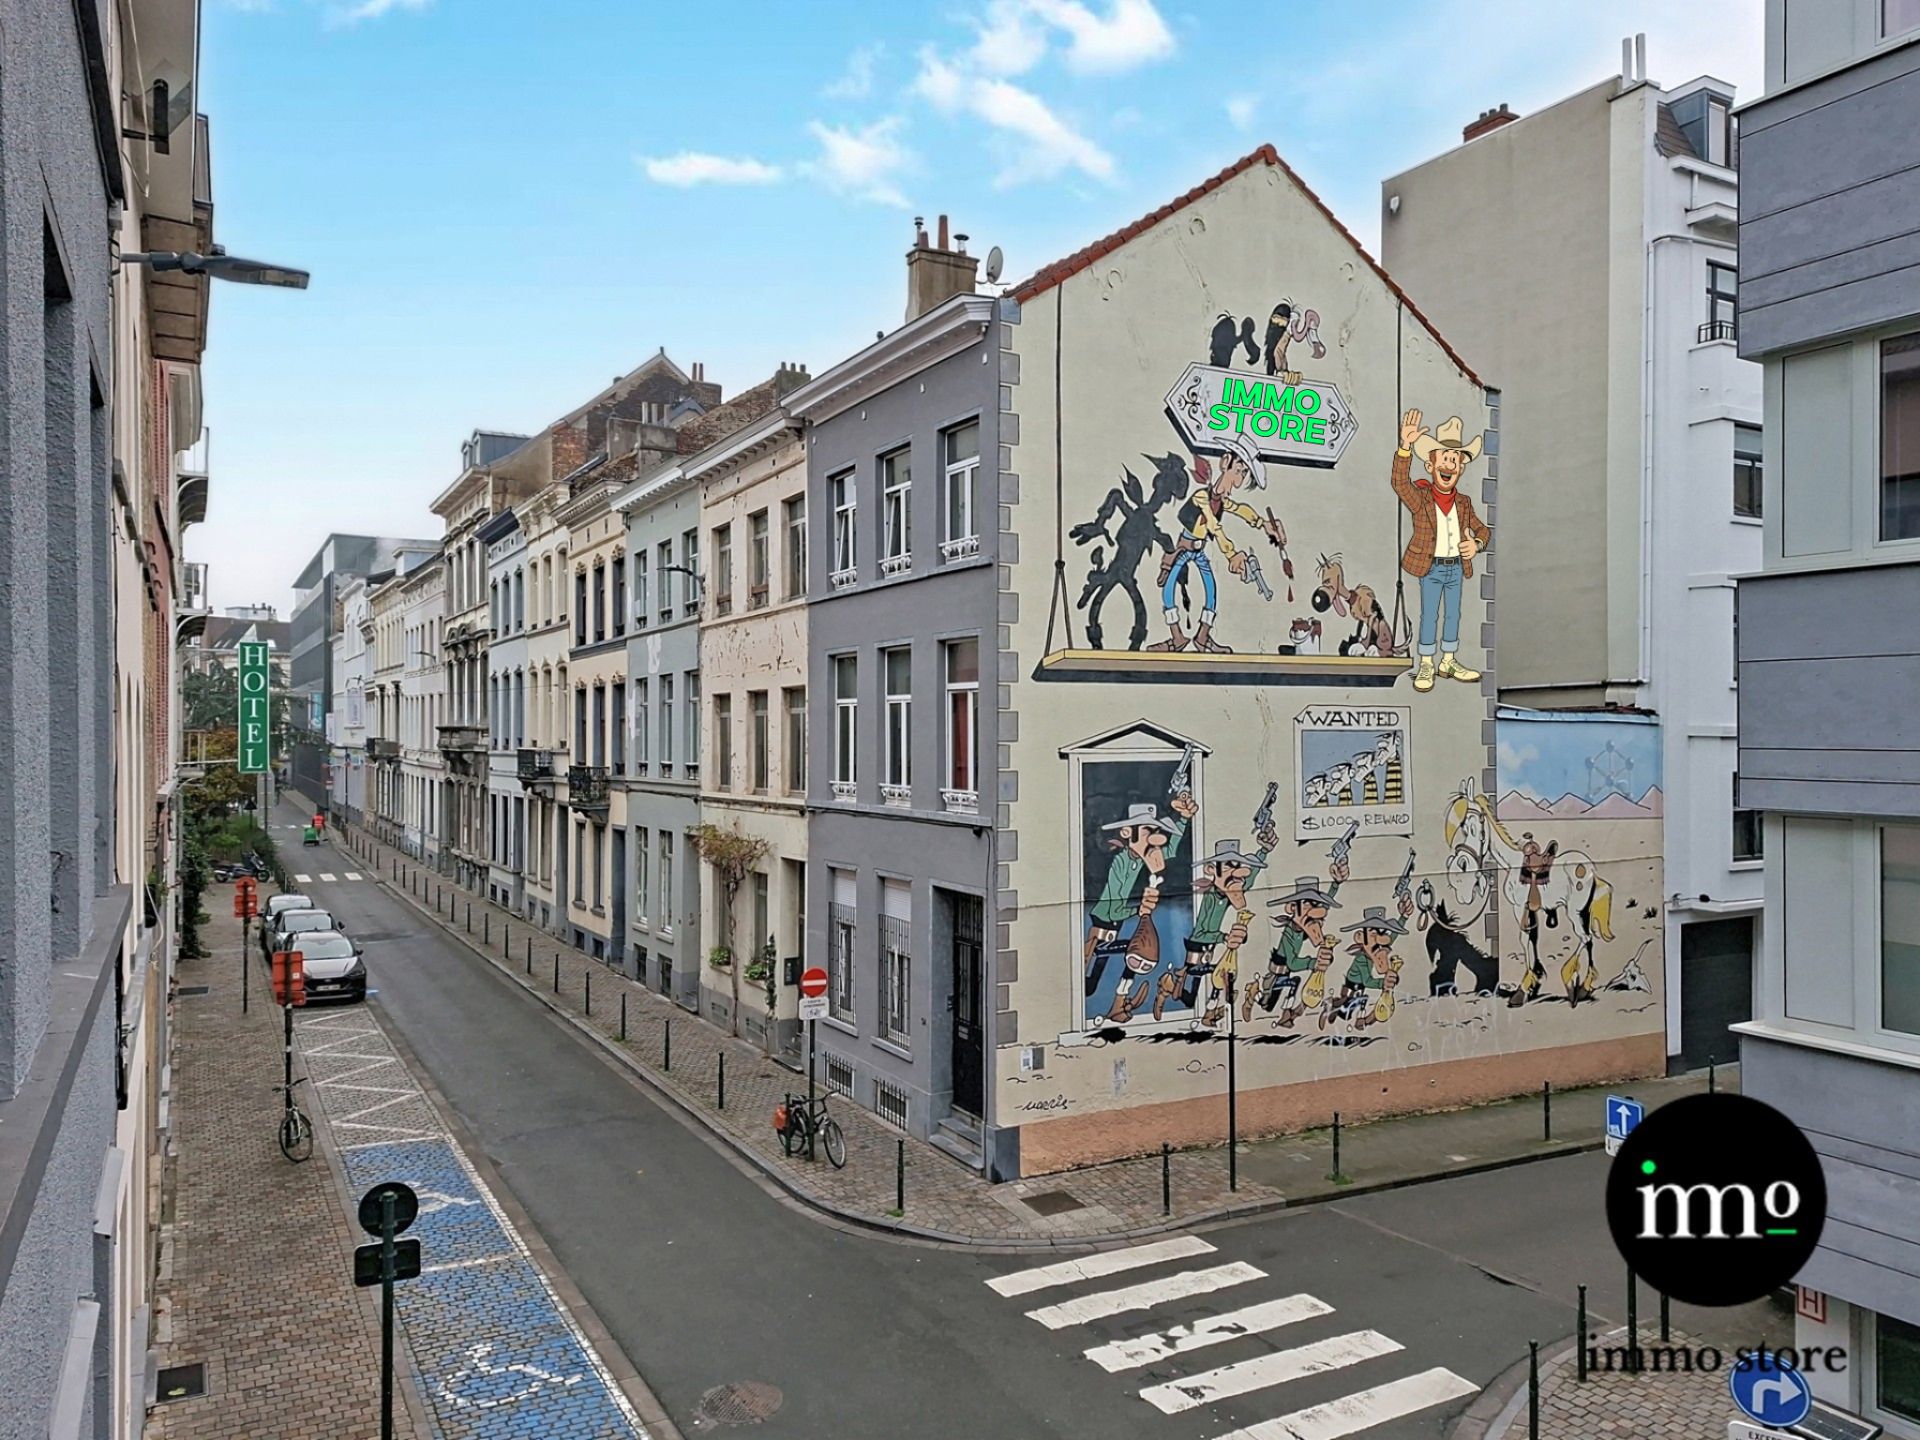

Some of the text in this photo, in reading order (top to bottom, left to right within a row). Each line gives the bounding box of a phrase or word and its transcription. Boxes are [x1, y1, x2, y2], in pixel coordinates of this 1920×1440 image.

[243, 645, 266, 769] HOTEL
[1306, 712, 1399, 726] WANTED
[1364, 813, 1410, 826] REWARD
